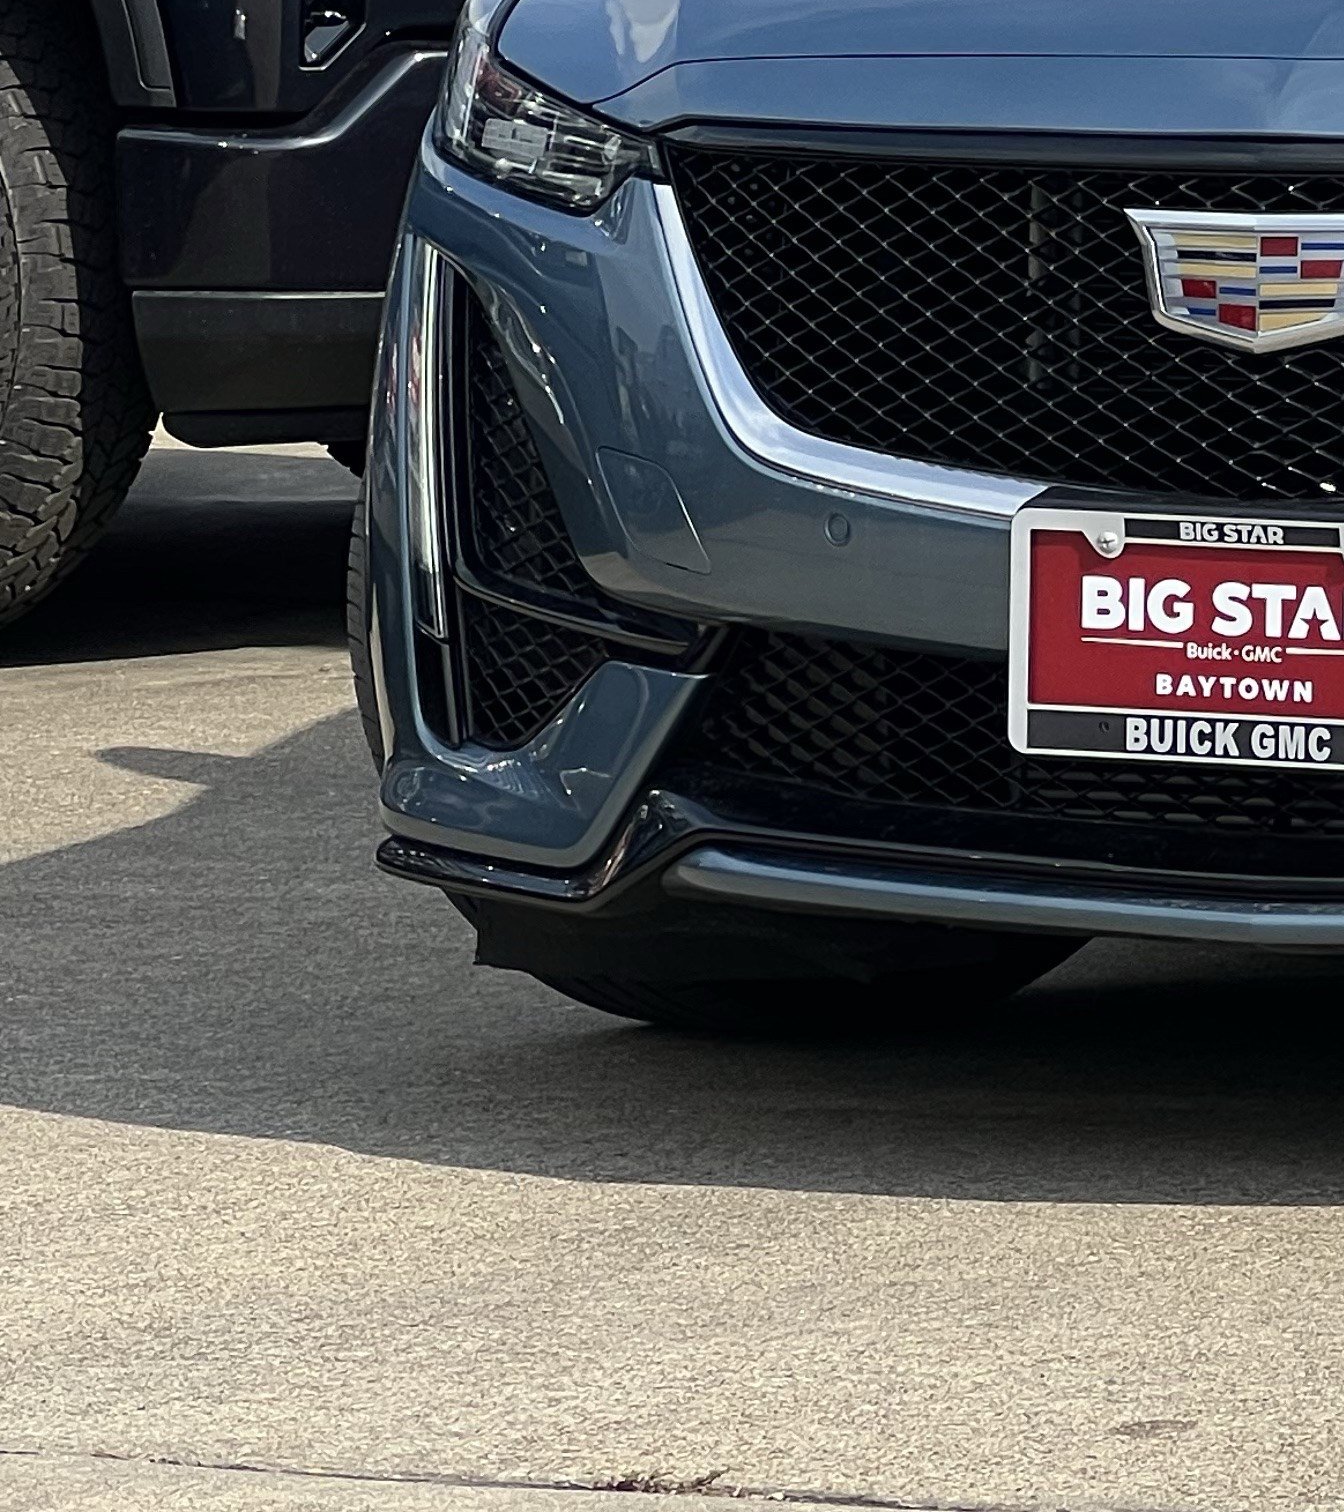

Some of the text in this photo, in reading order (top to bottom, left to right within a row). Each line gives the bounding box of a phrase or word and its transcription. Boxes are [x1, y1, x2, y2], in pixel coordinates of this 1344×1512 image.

[1179, 521, 1285, 545] BIG STAR
[1081, 575, 1195, 634] BIG
[1186, 641, 1284, 664] Buick GMC
[1154, 673, 1314, 704] BAYTOWN
[1124, 716, 1333, 763] BUICK GMC
